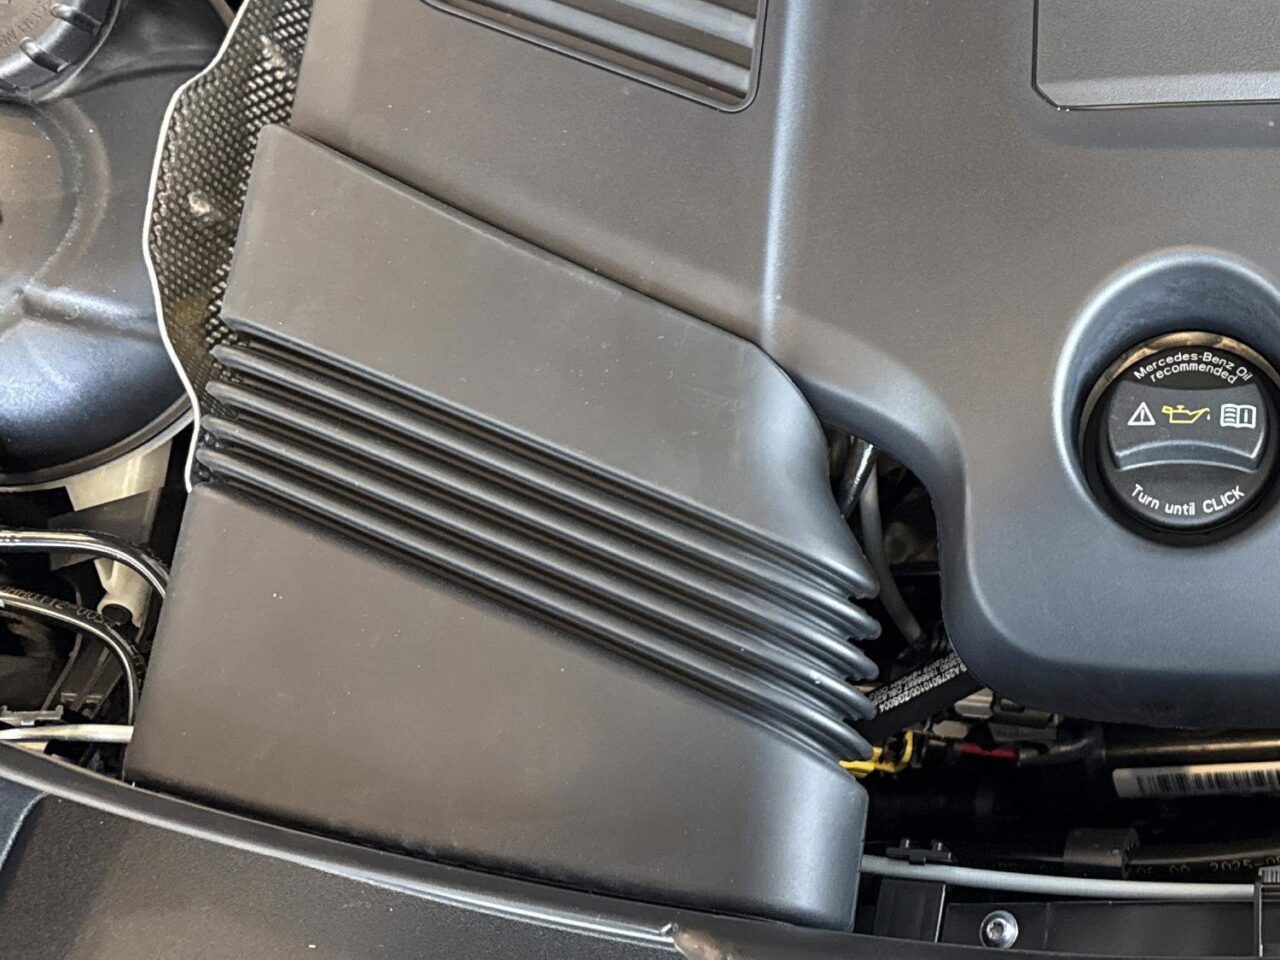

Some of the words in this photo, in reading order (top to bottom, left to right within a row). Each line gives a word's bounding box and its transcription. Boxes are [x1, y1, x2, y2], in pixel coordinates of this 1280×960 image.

[1133, 351, 1234, 381] Mercedes-Benz
[1237, 365, 1253, 382] Oil
[1150, 363, 1239, 385] recommended
[1131, 483, 1160, 510] Turn
[1165, 502, 1196, 516] until
[1202, 485, 1245, 514] CLICK
